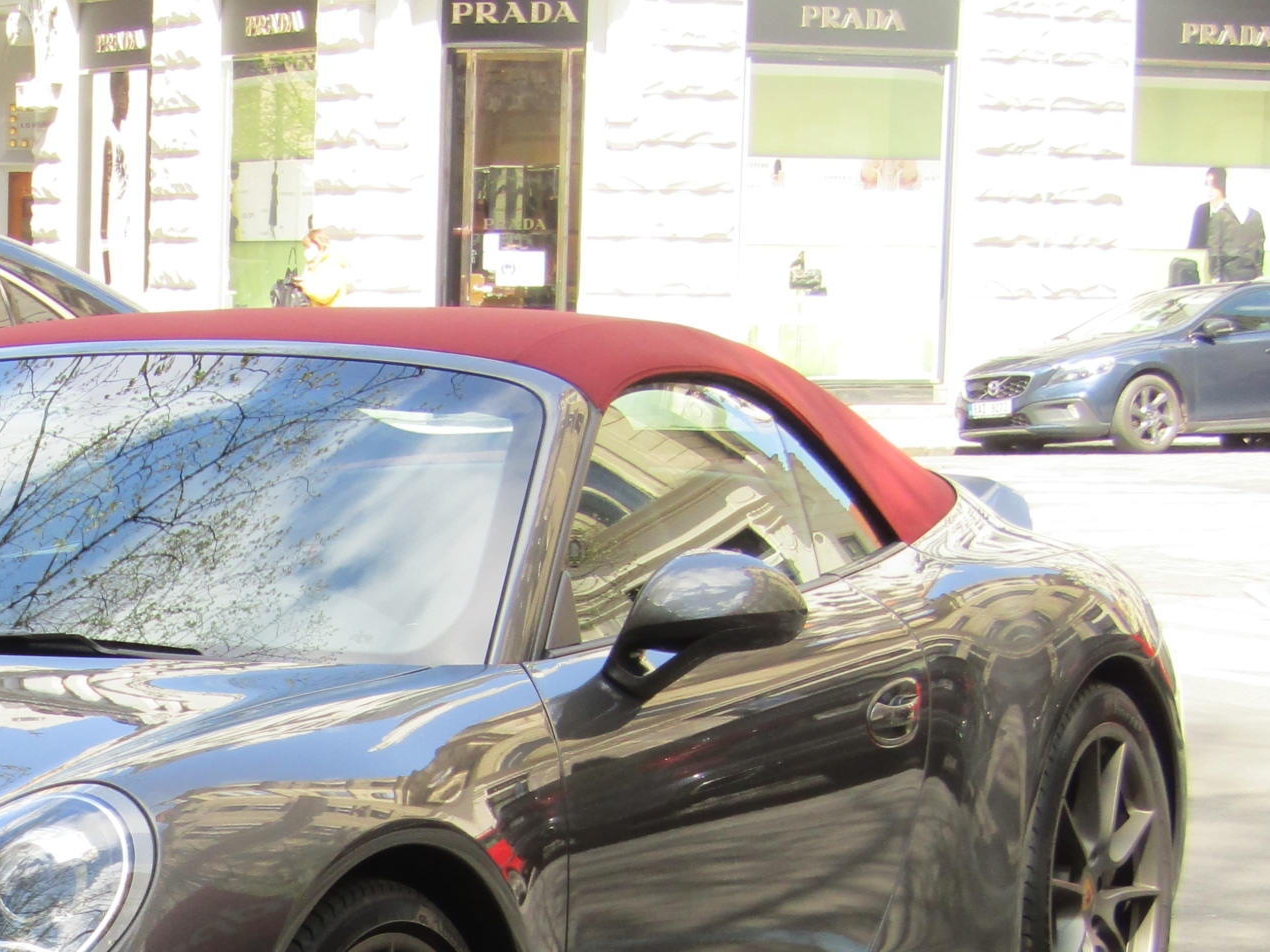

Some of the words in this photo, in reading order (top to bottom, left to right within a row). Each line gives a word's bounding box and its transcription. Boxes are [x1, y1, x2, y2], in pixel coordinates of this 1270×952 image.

[244, 10, 306, 37] PRADA
[450, 0, 579, 25] PRADA
[800, 5, 907, 32] PRADA
[95, 28, 146, 53] PRADA
[1180, 22, 1270, 47] PRADA
